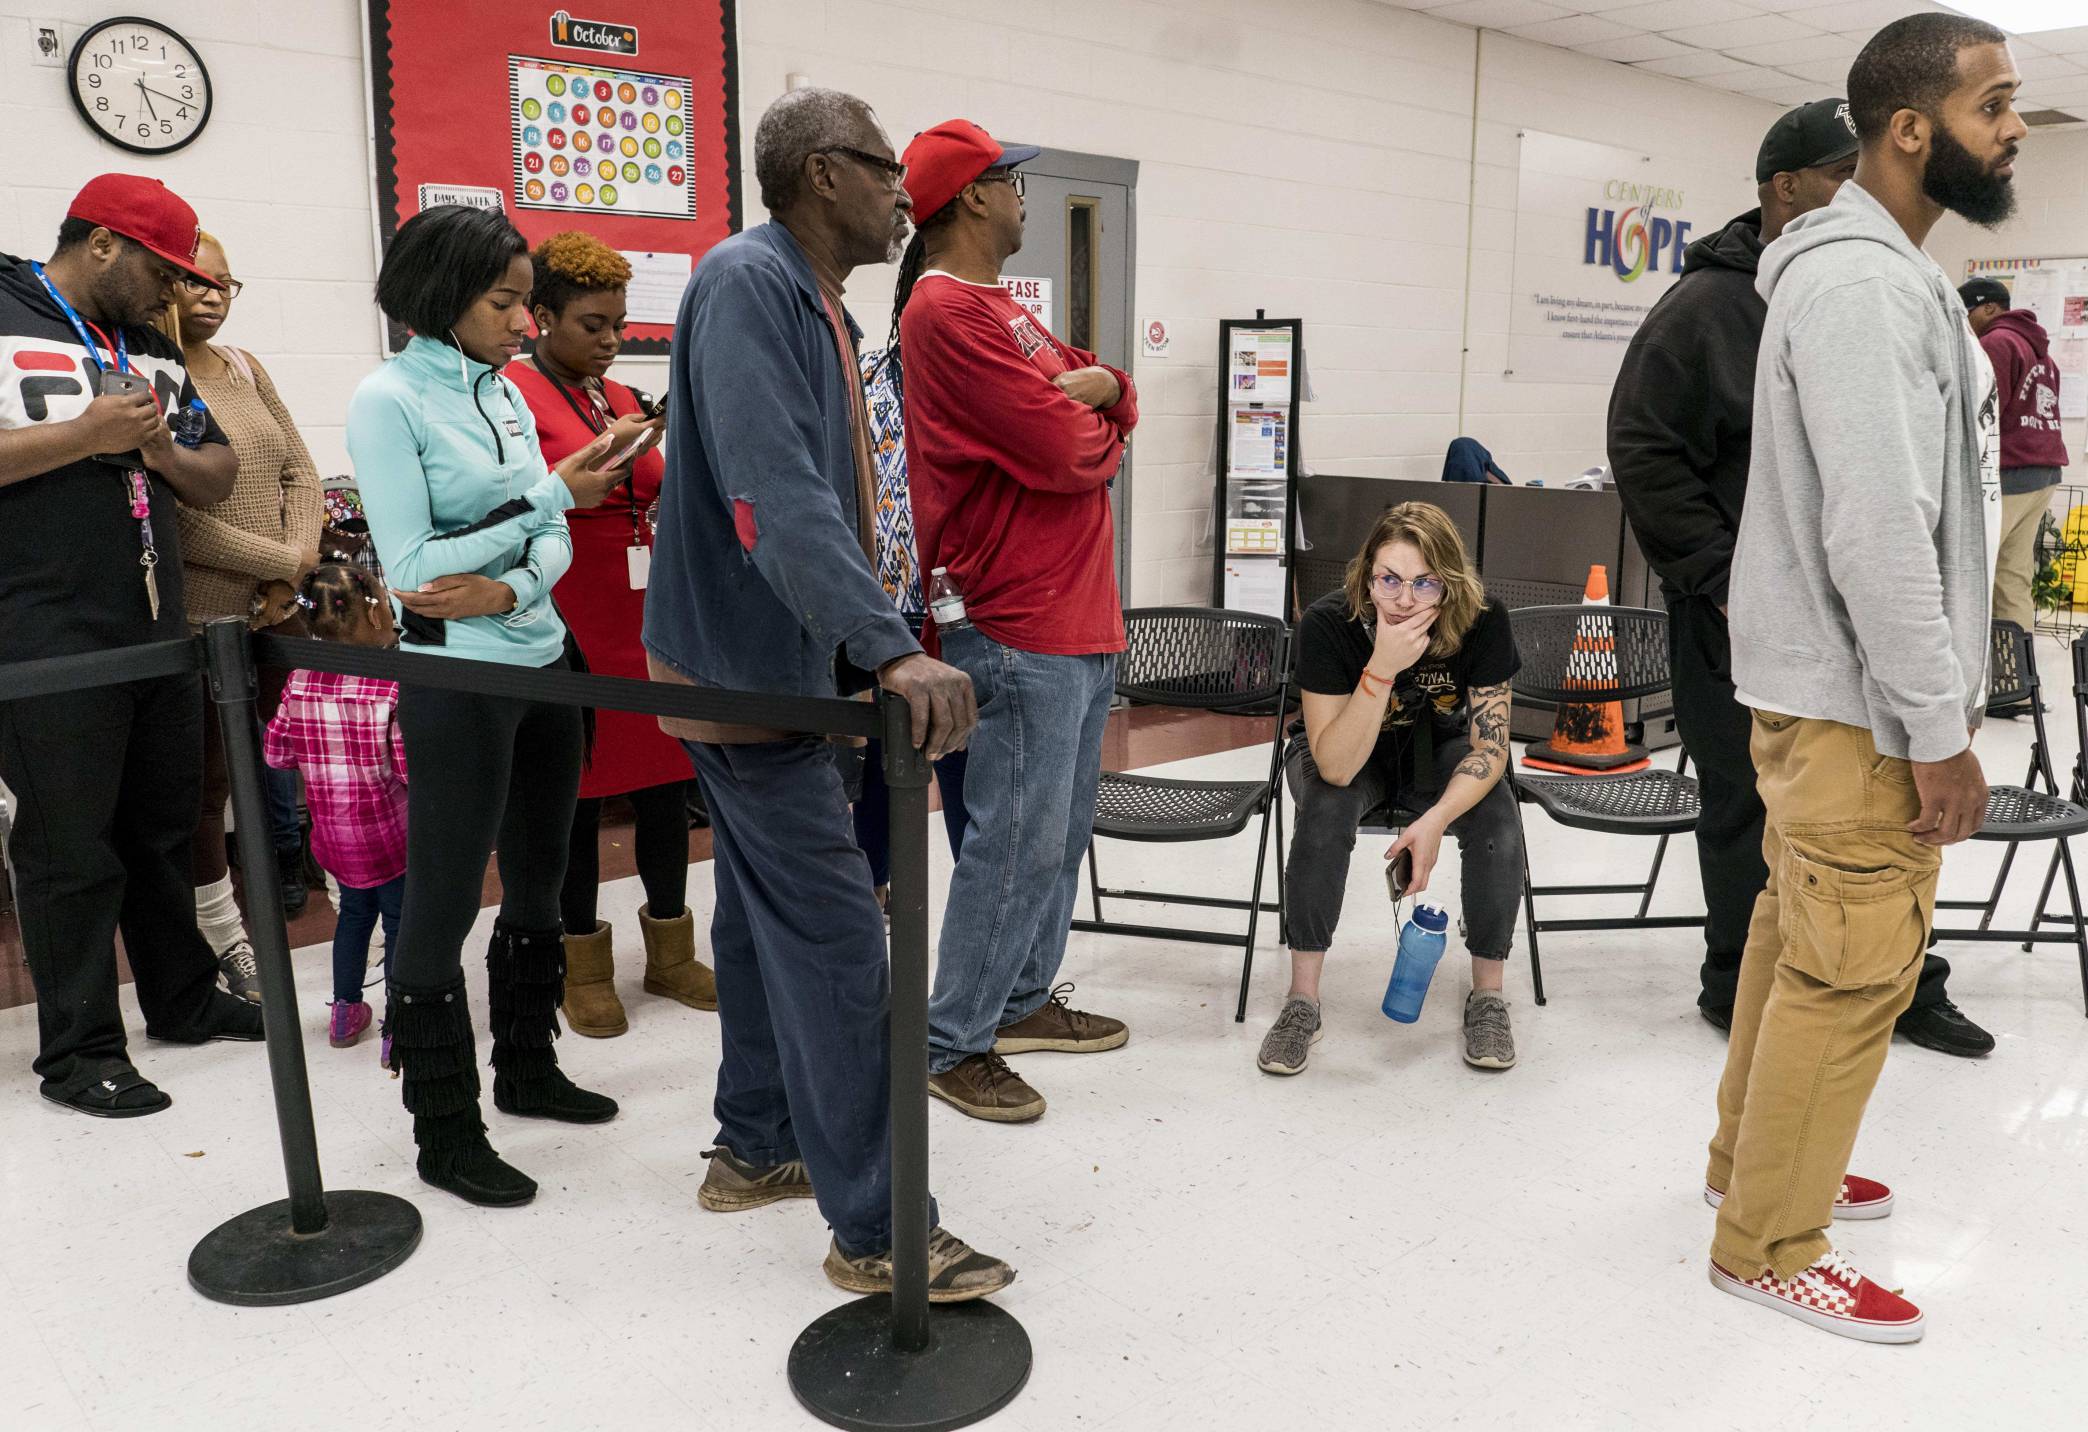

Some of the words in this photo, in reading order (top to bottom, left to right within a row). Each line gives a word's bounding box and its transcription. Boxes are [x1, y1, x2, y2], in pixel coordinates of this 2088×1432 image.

[130, 34, 149, 51] 12
[573, 24, 622, 48] October
[110, 38, 125, 55] 11
[159, 45, 166, 60] 1
[92, 53, 113, 70] 10
[174, 64, 186, 79] 2
[88, 73, 102, 89] 9
[181, 84, 194, 100] 3
[96, 96, 109, 112] 8
[114, 114, 127, 129] 7
[175, 106, 189, 121] 4
[137, 122, 151, 138] 6
[160, 119, 173, 135] 5
[625, 116, 632, 126] 11
[647, 118, 656, 128] 12
[527, 131, 537, 141] 14
[552, 134, 562, 145] 15
[578, 137, 588, 147] 16
[602, 139, 611, 149] 17
[648, 143, 657, 153] 19
[669, 145, 680, 156] 20
[528, 157, 539, 169] 21
[553, 161, 566, 171] 22
[576, 162, 589, 173] 23
[626, 167, 637, 178] 25
[648, 169, 659, 179] 26
[671, 171, 682, 181] 27
[434, 193, 458, 204] DAYS
[466, 195, 491, 206] WEEK
[529, 184, 541, 195] 28
[553, 187, 566, 198] 29
[605, 190, 613, 201] 31
[1604, 179, 1684, 209] CENTERS
[1640, 196, 1655, 232] of
[1583, 206, 1692, 282] HOPE
[1030, 304, 1043, 315] OR
